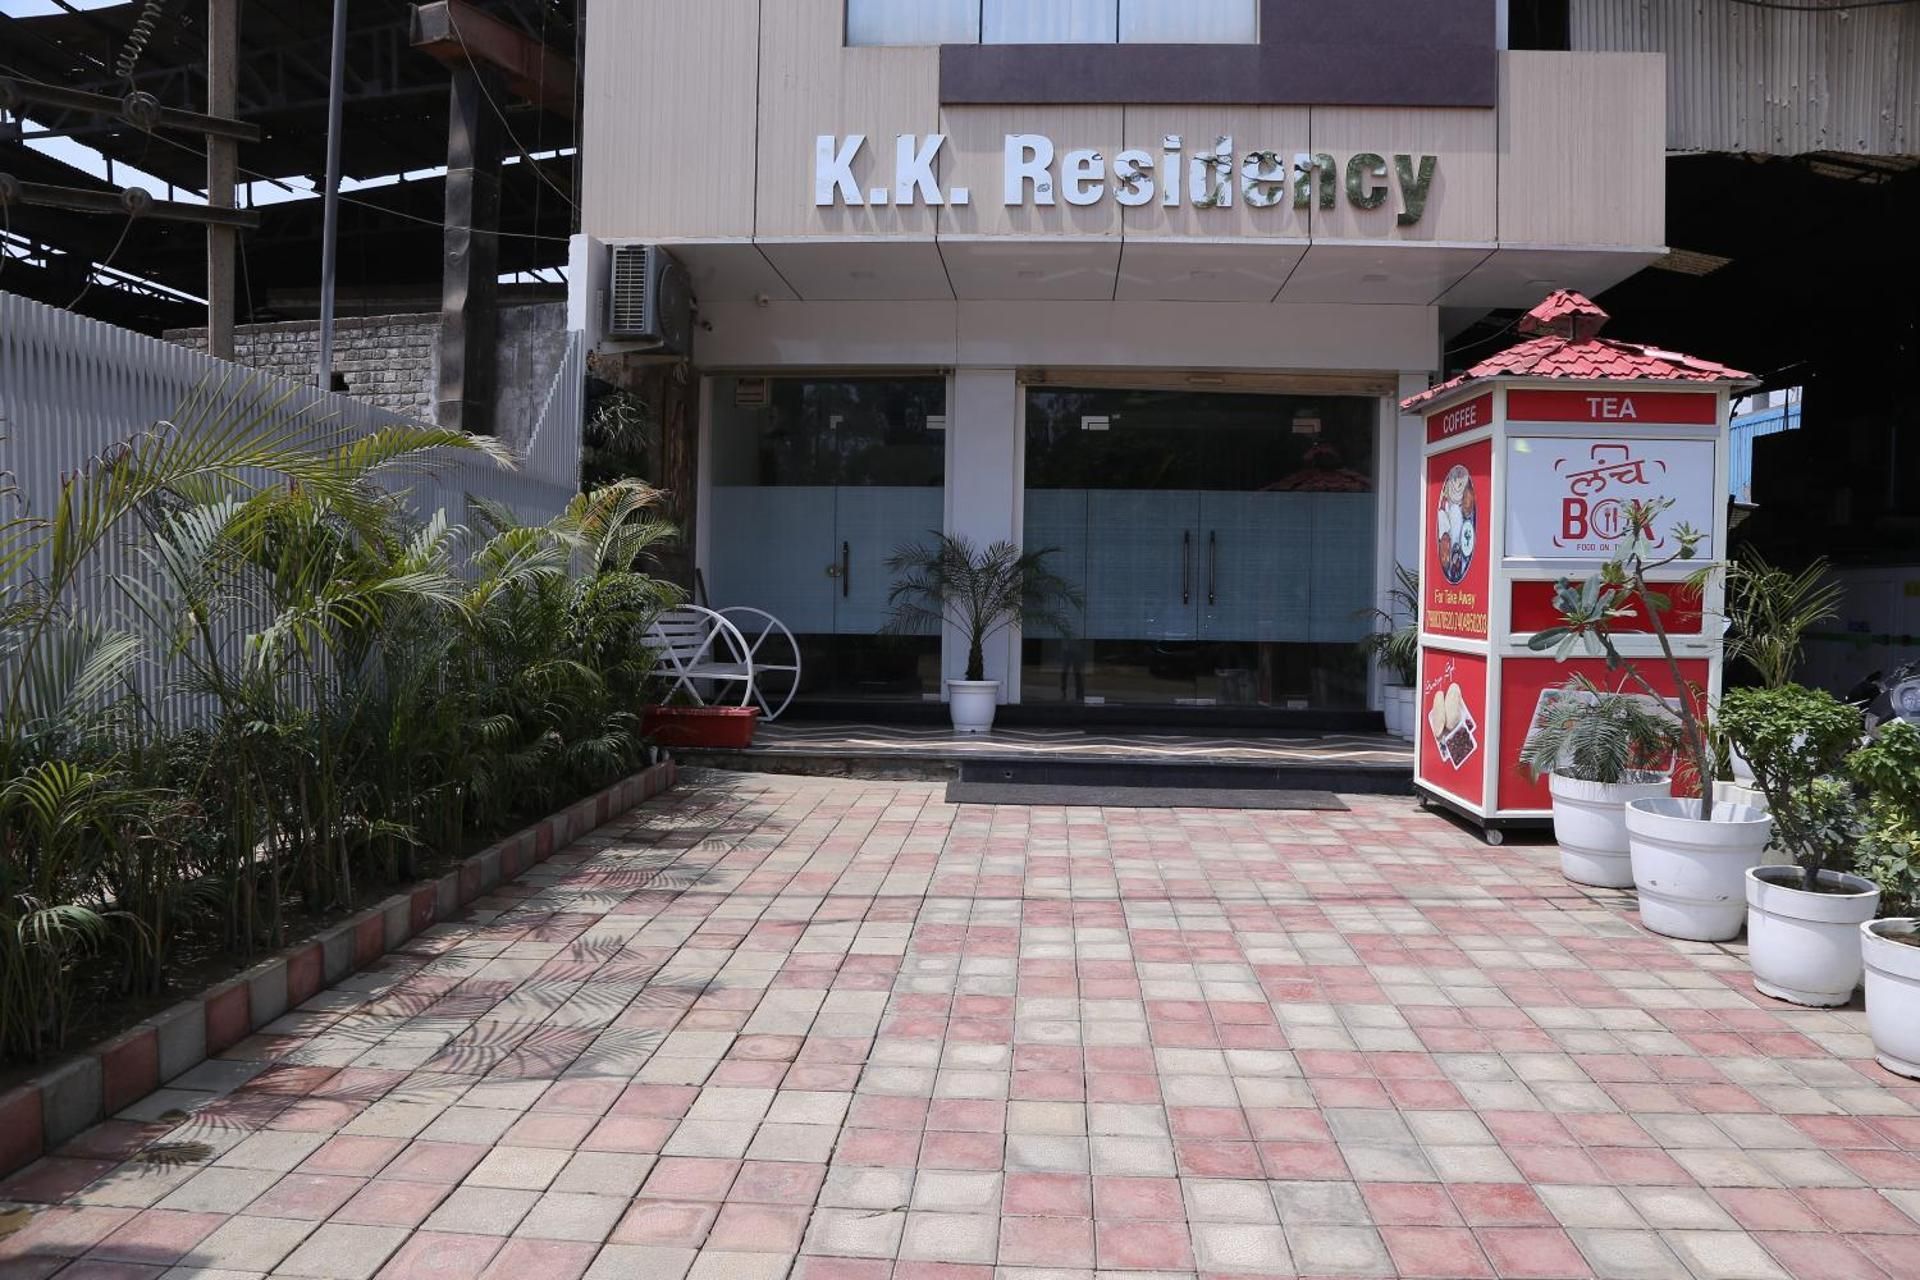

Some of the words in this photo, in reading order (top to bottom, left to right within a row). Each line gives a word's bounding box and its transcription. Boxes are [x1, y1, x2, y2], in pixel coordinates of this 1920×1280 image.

[815, 134, 969, 206] K.K.
[1004, 135, 1437, 226] Residency
[1443, 405, 1477, 434] COFFEE
[1586, 397, 1637, 419] TEA
[1565, 458, 1651, 496] लंच
[1576, 543, 1596, 551] FOOD
[1599, 543, 1610, 551] ON
